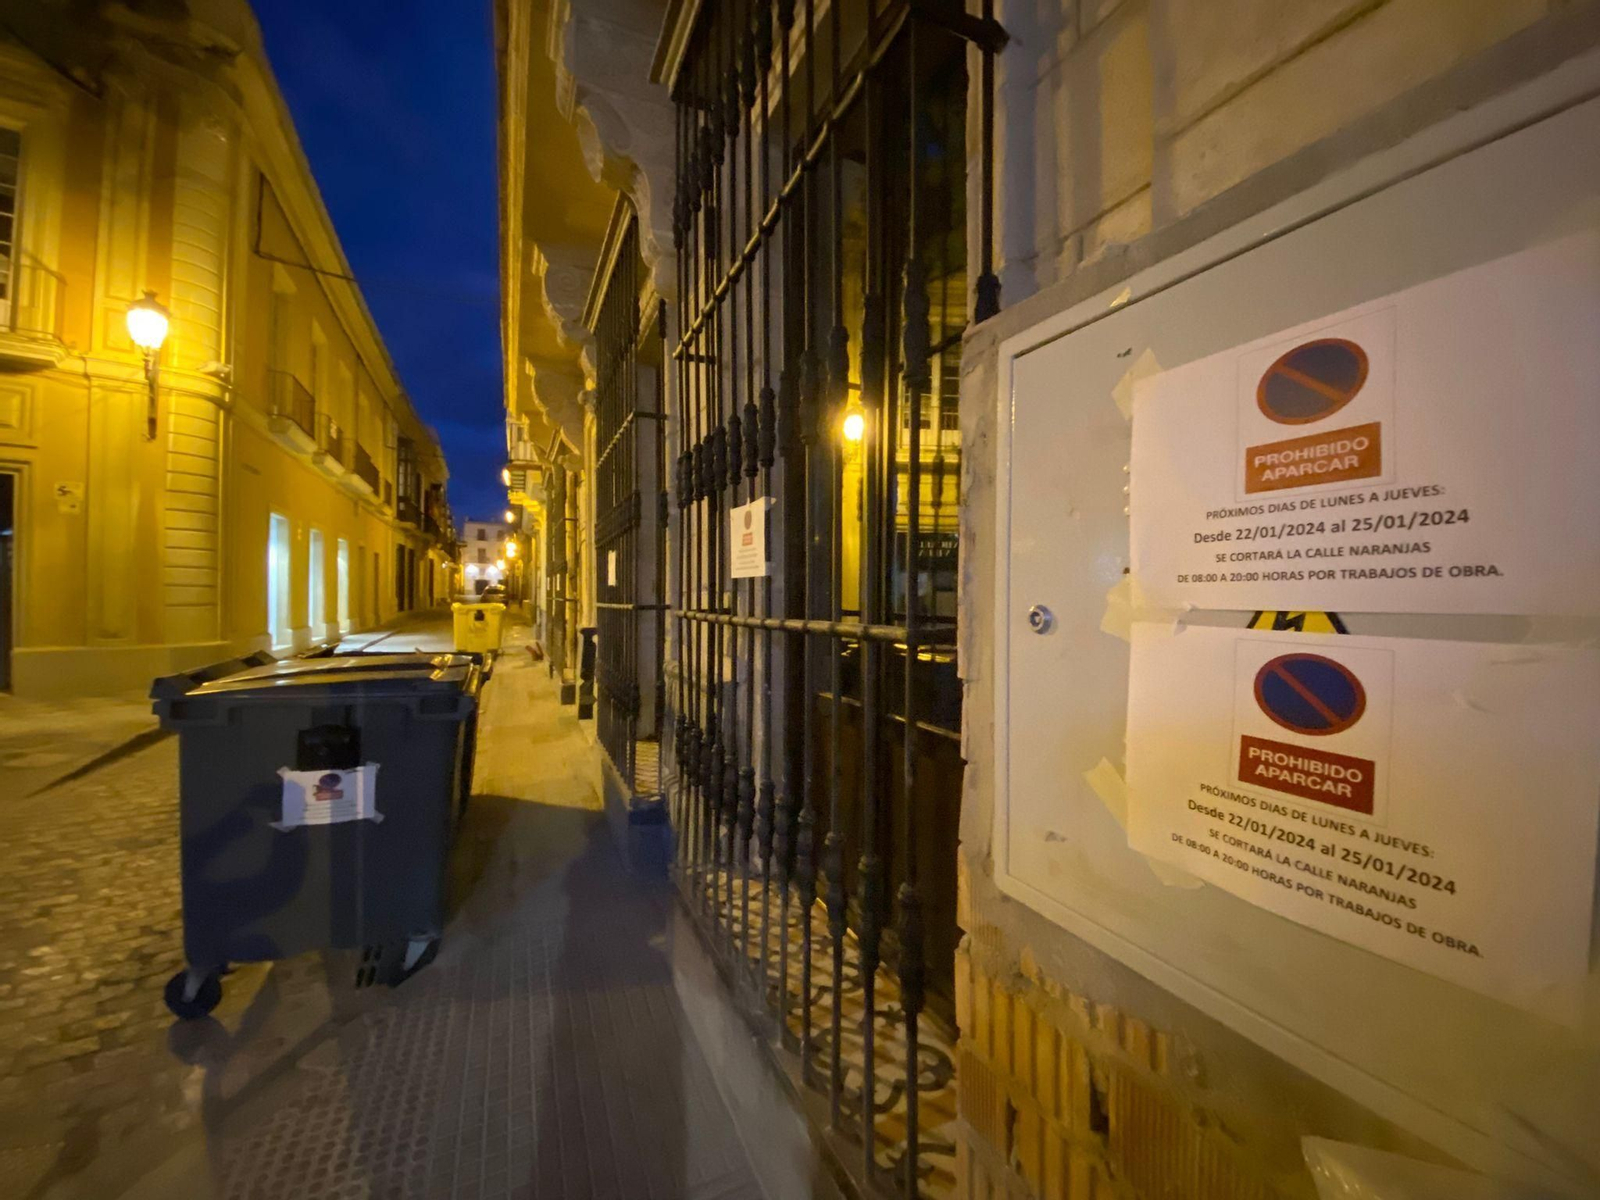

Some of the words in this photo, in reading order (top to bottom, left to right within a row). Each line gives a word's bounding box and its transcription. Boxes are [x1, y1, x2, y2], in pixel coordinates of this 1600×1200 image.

[1254, 437, 1369, 468] PROHIBIDO
[1262, 455, 1359, 482] APARCAR
[1206, 505, 1265, 520] PRÓXIMOS
[1268, 501, 1296, 514] DIAS
[1300, 499, 1317, 510] DE
[1320, 493, 1365, 509] LUNES
[1369, 492, 1379, 503] A
[1383, 484, 1446, 502] JUEVES:
[1194, 530, 1232, 543] Desde
[1236, 521, 1325, 541] 22/01/2024
[1331, 519, 1346, 533] al
[1352, 509, 1470, 533] 25/01/2024
[1216, 553, 1227, 563] SE
[1286, 549, 1302, 559] LA
[1305, 546, 1344, 558] CALLE
[1349, 541, 1431, 556] NARANJAS
[1177, 574, 1189, 583] DE
[1192, 573, 1217, 582] 08:00
[1219, 573, 1227, 582] A
[1230, 572, 1259, 582] 20:00
[1262, 570, 1304, 582] HORAS
[1308, 569, 1336, 580] POR
[1341, 567, 1417, 579] TRABAJOS
[1421, 566, 1443, 578] DE
[1448, 565, 1504, 578] OBRA.
[1248, 746, 1362, 783] PROHIBIDO
[1255, 764, 1352, 798] APARCAR
[1200, 783, 1257, 808] PRÓXIMOS
[1260, 800, 1288, 817] DIAS
[1291, 809, 1308, 823] DE
[1311, 814, 1356, 836] LUNES
[1359, 829, 1370, 840] A
[1374, 832, 1434, 858] JUEVES:
[1187, 799, 1225, 821] Desde
[1228, 812, 1315, 851] 22/01/2024
[1320, 843, 1336, 857] al
[1340, 848, 1457, 895] 25/01/2024
[1209, 828, 1220, 840] SE
[1275, 852, 1291, 868] LA
[1295, 860, 1334, 881] CALLE
[1337, 873, 1417, 910] NARANJAS
[1171, 832, 1183, 844] DE
[1185, 838, 1211, 855] 08:00
[1213, 850, 1220, 859] A
[1222, 853, 1249, 872] 20:00
[1252, 866, 1293, 890] HORAS
[1296, 882, 1324, 901] POR
[1328, 893, 1402, 930] TRABAJOS
[1406, 922, 1427, 938] DE
[1432, 932, 1484, 959] OBRA.
